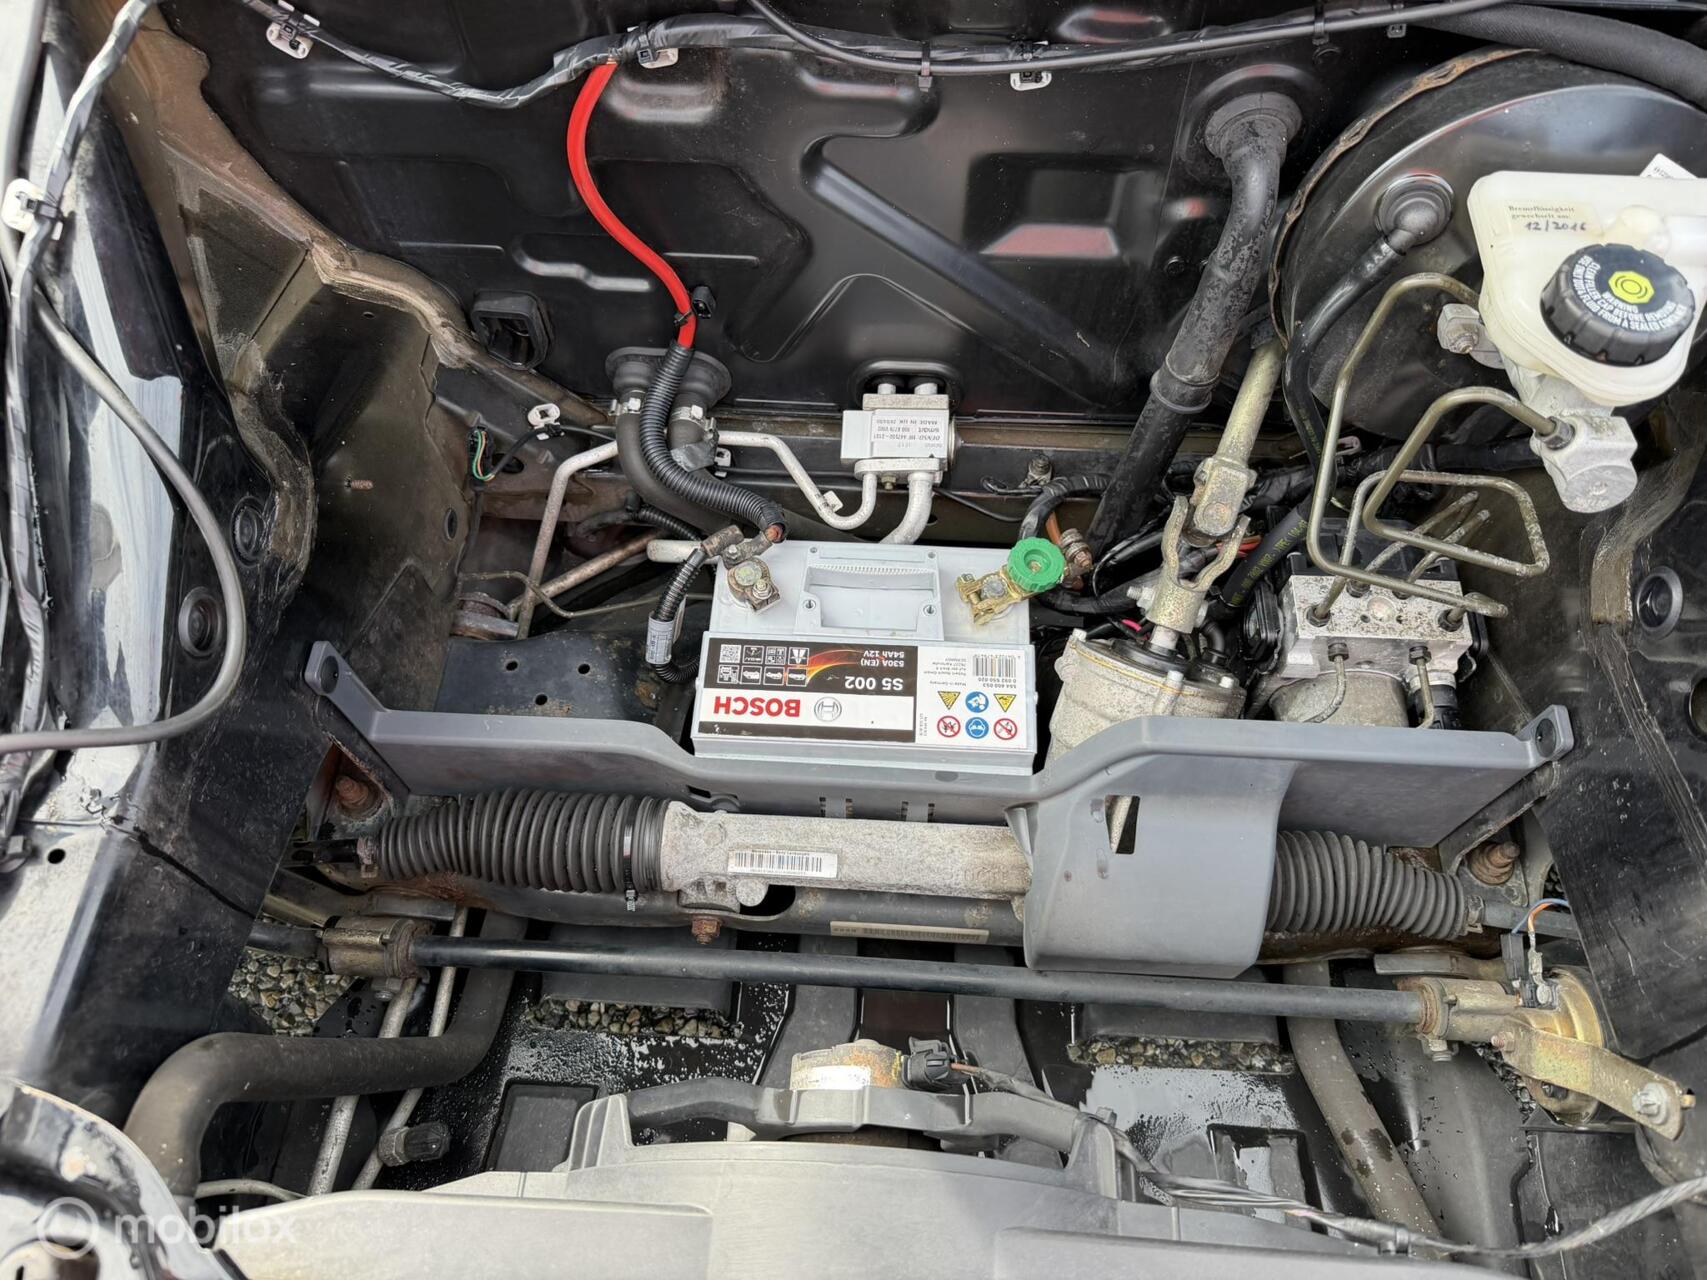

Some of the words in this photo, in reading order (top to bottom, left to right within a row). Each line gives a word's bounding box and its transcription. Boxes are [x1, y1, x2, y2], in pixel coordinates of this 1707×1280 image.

[1525, 220, 1586, 232] 12/2016
[1584, 279, 1602, 301] FILLER
[1597, 299, 1614, 311] CAP
[1613, 308, 1645, 322] BEFORE
[1602, 291, 1639, 314] WARNING
[1581, 293, 1600, 313] FLUID
[1598, 309, 1621, 326] FROM
[1621, 318, 1629, 329] A
[860, 658, 880, 667] (EN)
[882, 659, 904, 668] 530A
[845, 676, 876, 690] 002
[882, 677, 904, 690] S5
[714, 696, 800, 718] BOSCH
